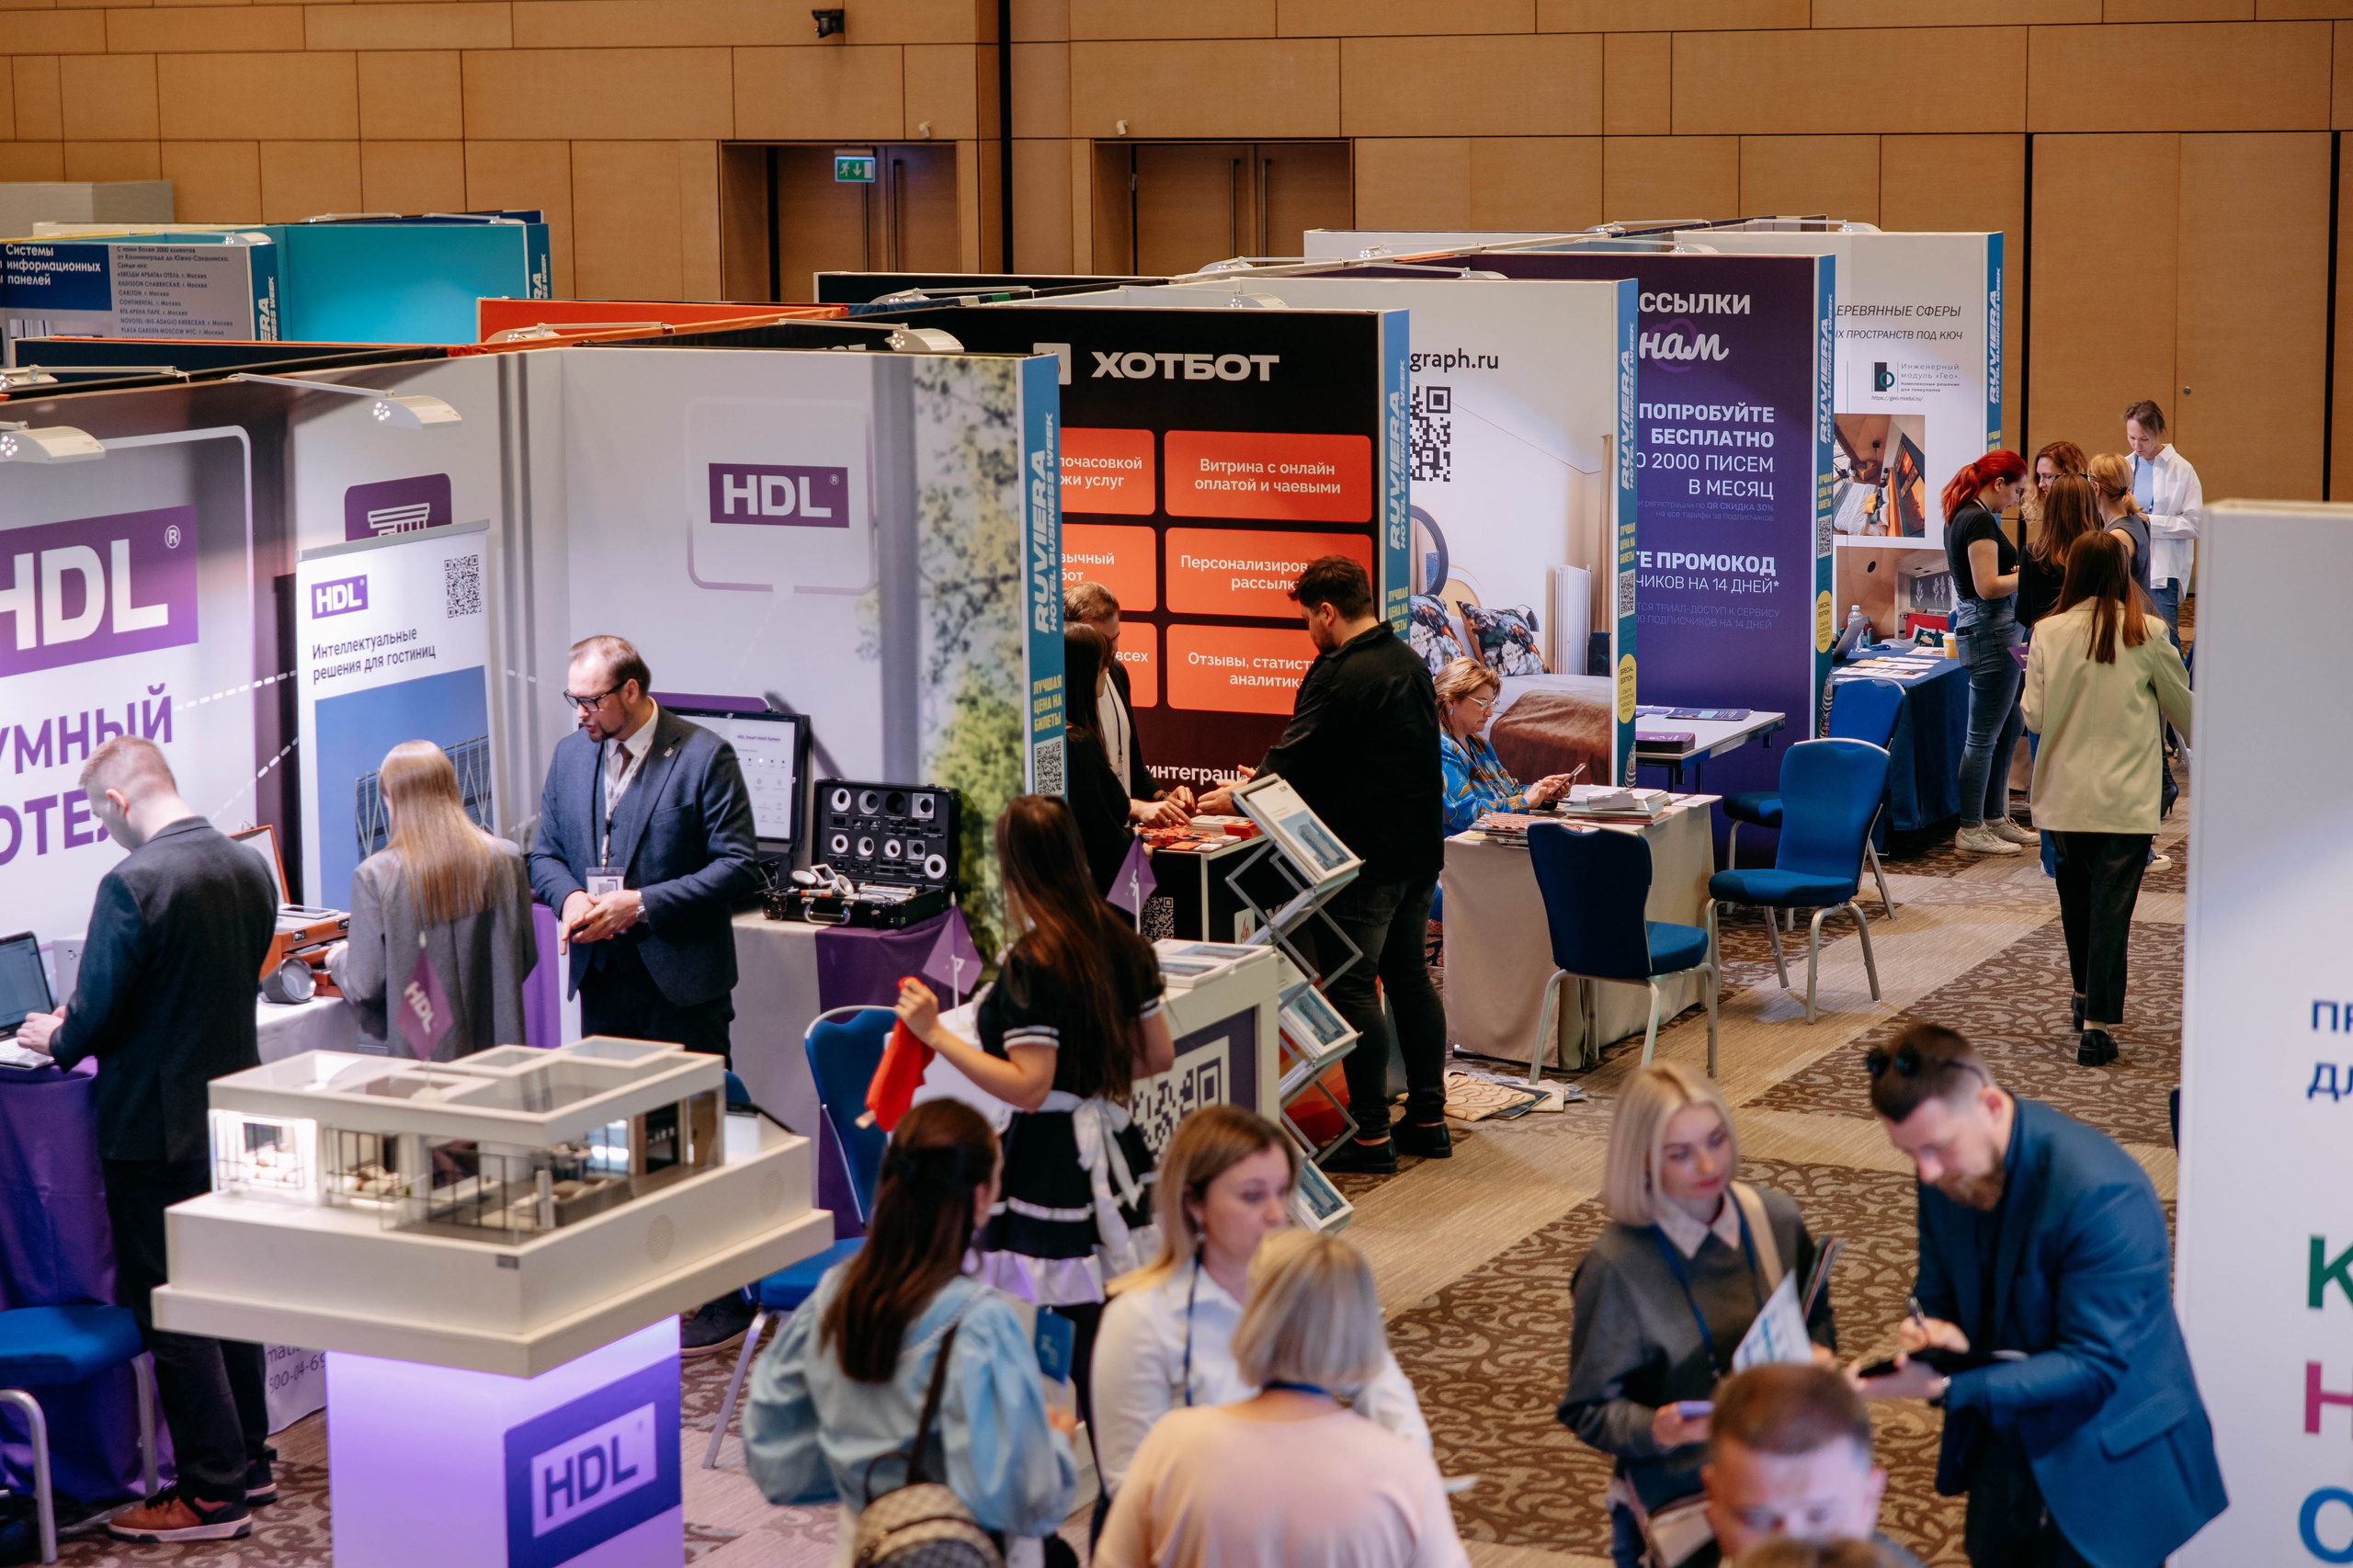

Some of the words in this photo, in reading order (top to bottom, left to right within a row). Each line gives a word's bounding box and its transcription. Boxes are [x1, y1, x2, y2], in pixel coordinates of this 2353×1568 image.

[6, 244, 53, 256] Системы
[7, 258, 101, 273] информационных
[7, 274, 51, 285] панелей
[1638, 292, 1750, 314] ССЫЛКИ
[1835, 305, 1913, 317] ЕРЕВЯННЫЕ
[1915, 305, 1961, 316] СФЕРЫ
[1847, 330, 1914, 339] ПРОСТРАНСТВ
[1916, 331, 1938, 340] ПОД
[1939, 331, 1962, 340] КЮЧ
[1639, 333, 1730, 361] нам
[1091, 351, 1279, 381] ХОТБОТ
[1410, 348, 1499, 373] graph.ru
[1901, 363, 1960, 371] Инженерный
[1640, 403, 1774, 423] ПОПРОБУЙТЕ
[1045, 413, 1053, 468] WEEK
[1651, 428, 1774, 448] БЕСПЛАТНО
[1200, 458, 1264, 475] Витрина
[1267, 463, 1276, 472] с
[1279, 461, 1335, 474] онлайн
[1390, 392, 1401, 550] RUVIERA
[1653, 453, 1699, 471] 2000
[1706, 454, 1774, 472] ПИСЕМ
[1085, 476, 1125, 490] услуг
[1195, 478, 1256, 491] оплатой
[1261, 482, 1269, 491] и
[1274, 482, 1341, 494] чаевыми
[1688, 480, 1700, 494] В
[1707, 480, 1774, 500] МЕСЯЦ
[1645, 501, 1695, 509] регистрации
[1046, 471, 1057, 564] BUSINESS
[1682, 512, 1711, 520] тарифы
[1723, 513, 1774, 522] подписчиков
[1031, 450, 1050, 634] RUVIERA
[1636, 551, 1653, 568] Е
[1656, 551, 1776, 577] ПРОМОКОД
[1232, 577, 1299, 591] рассылк
[1689, 577, 1709, 590] НА
[1712, 577, 1728, 592] 14
[1049, 570, 1057, 632] HOTEL
[1656, 603, 1726, 616] ТРИАЛ-ДОСТУП
[1729, 608, 1735, 616] К
[1737, 607, 1779, 618] СЕРВИСУ
[1647, 615, 1717, 627] ПОДПИСЧИКОВ
[1734, 619, 1745, 628] 14
[1746, 619, 1772, 630] ДНЕЙ
[313, 629, 417, 660] Интеллектуальные
[313, 660, 360, 685] решения
[364, 655, 384, 673] для
[388, 645, 436, 665] гостиниц
[1188, 652, 1249, 669] Отзывы,
[1253, 658, 1314, 670] статист
[1034, 674, 1063, 695] ЛУЧШАЯ
[1230, 675, 1304, 687] аналитик
[1034, 696, 1051, 715] ЦЕНА
[1053, 693, 1063, 708] НА
[1035, 711, 1061, 732] БИЛЕТЫ
